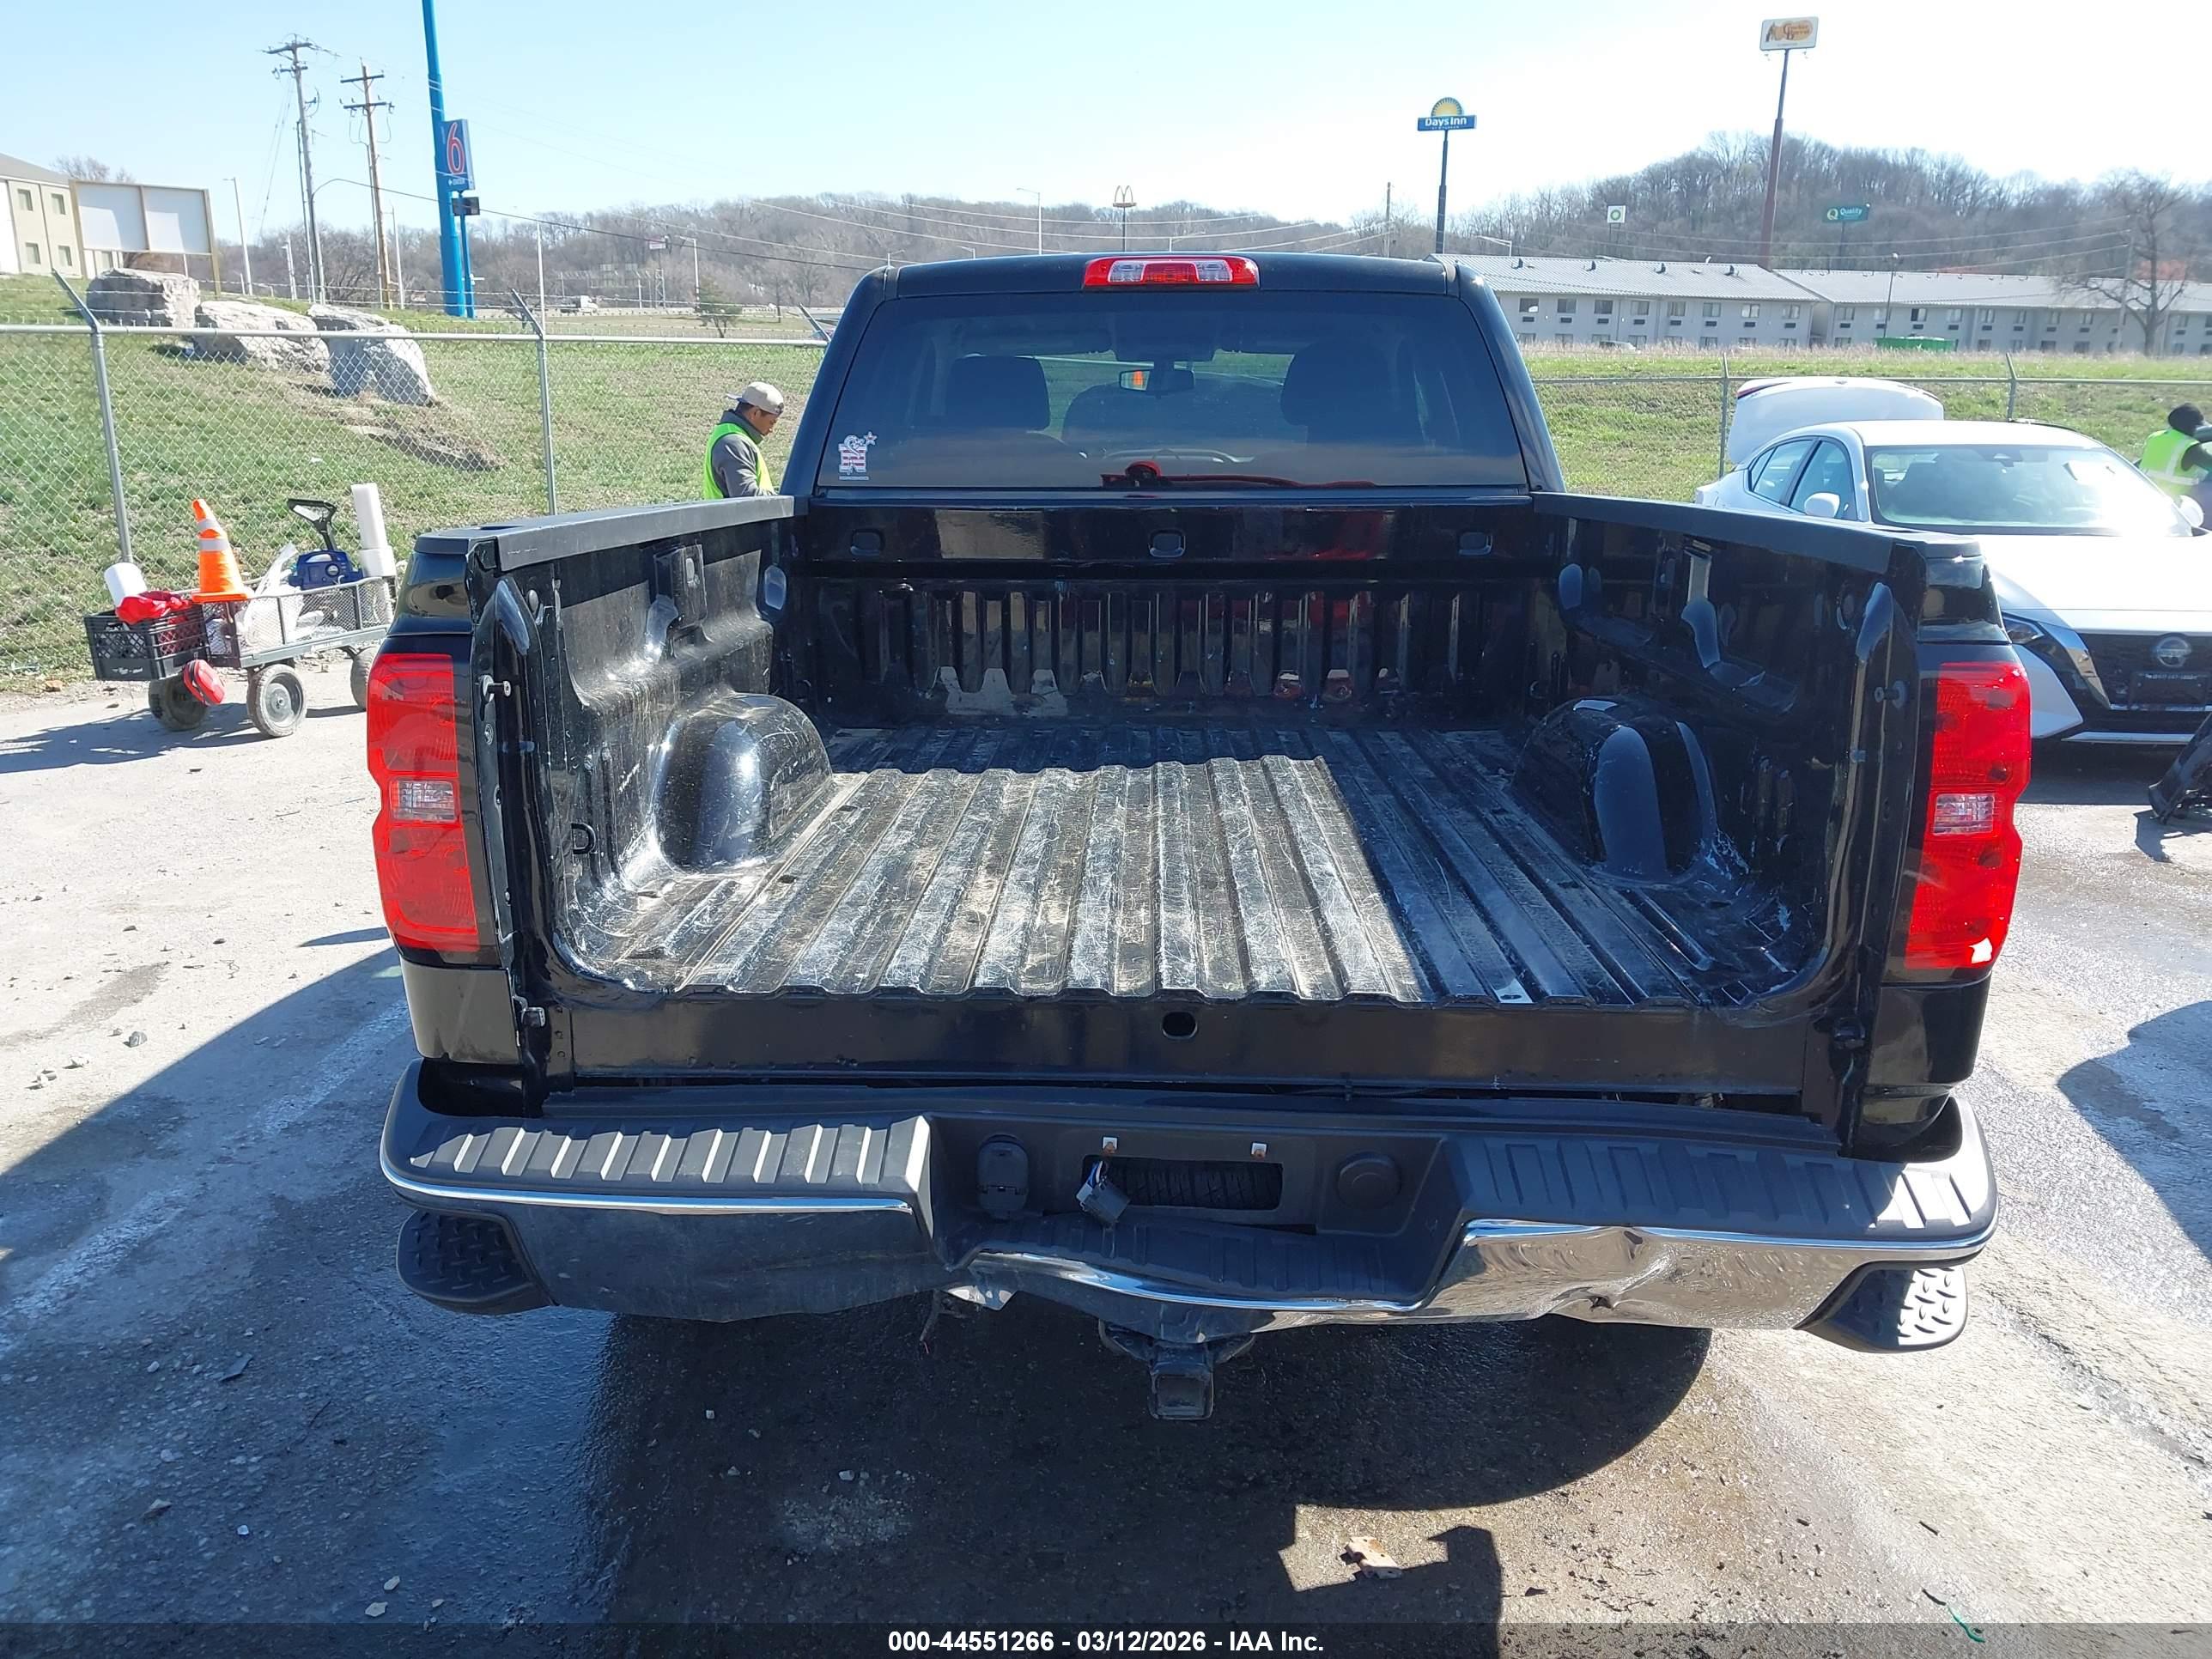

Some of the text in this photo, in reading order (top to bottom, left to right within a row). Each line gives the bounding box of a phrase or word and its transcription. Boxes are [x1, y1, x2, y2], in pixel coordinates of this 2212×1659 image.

[1425, 116, 1468, 127] Days Inn
[447, 122, 465, 175] 6
[1839, 207, 1863, 216] Quality
